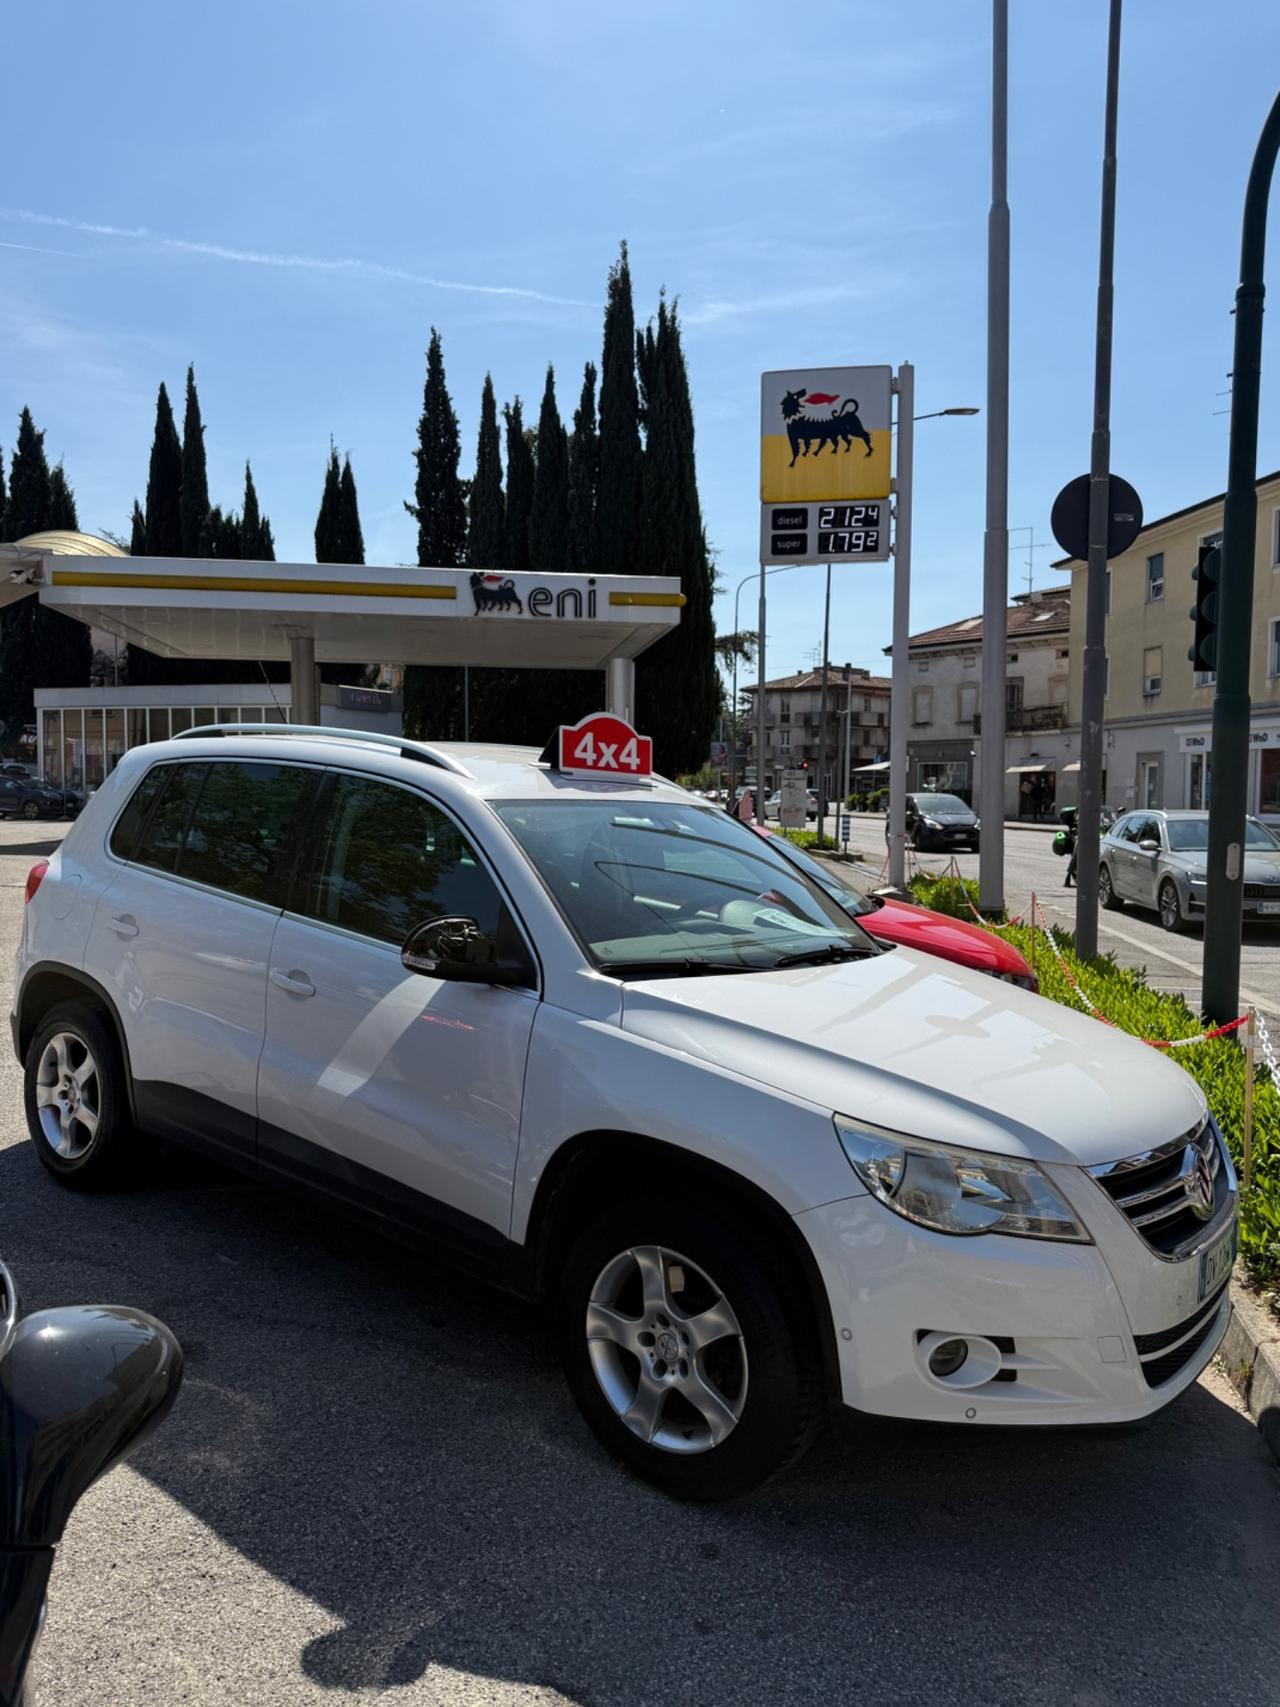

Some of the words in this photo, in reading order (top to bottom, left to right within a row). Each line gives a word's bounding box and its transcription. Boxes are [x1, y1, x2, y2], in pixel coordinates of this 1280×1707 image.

[777, 515, 802, 525] diesel
[777, 540, 801, 550] super
[528, 578, 596, 618] eni
[574, 732, 640, 770] 4x4
